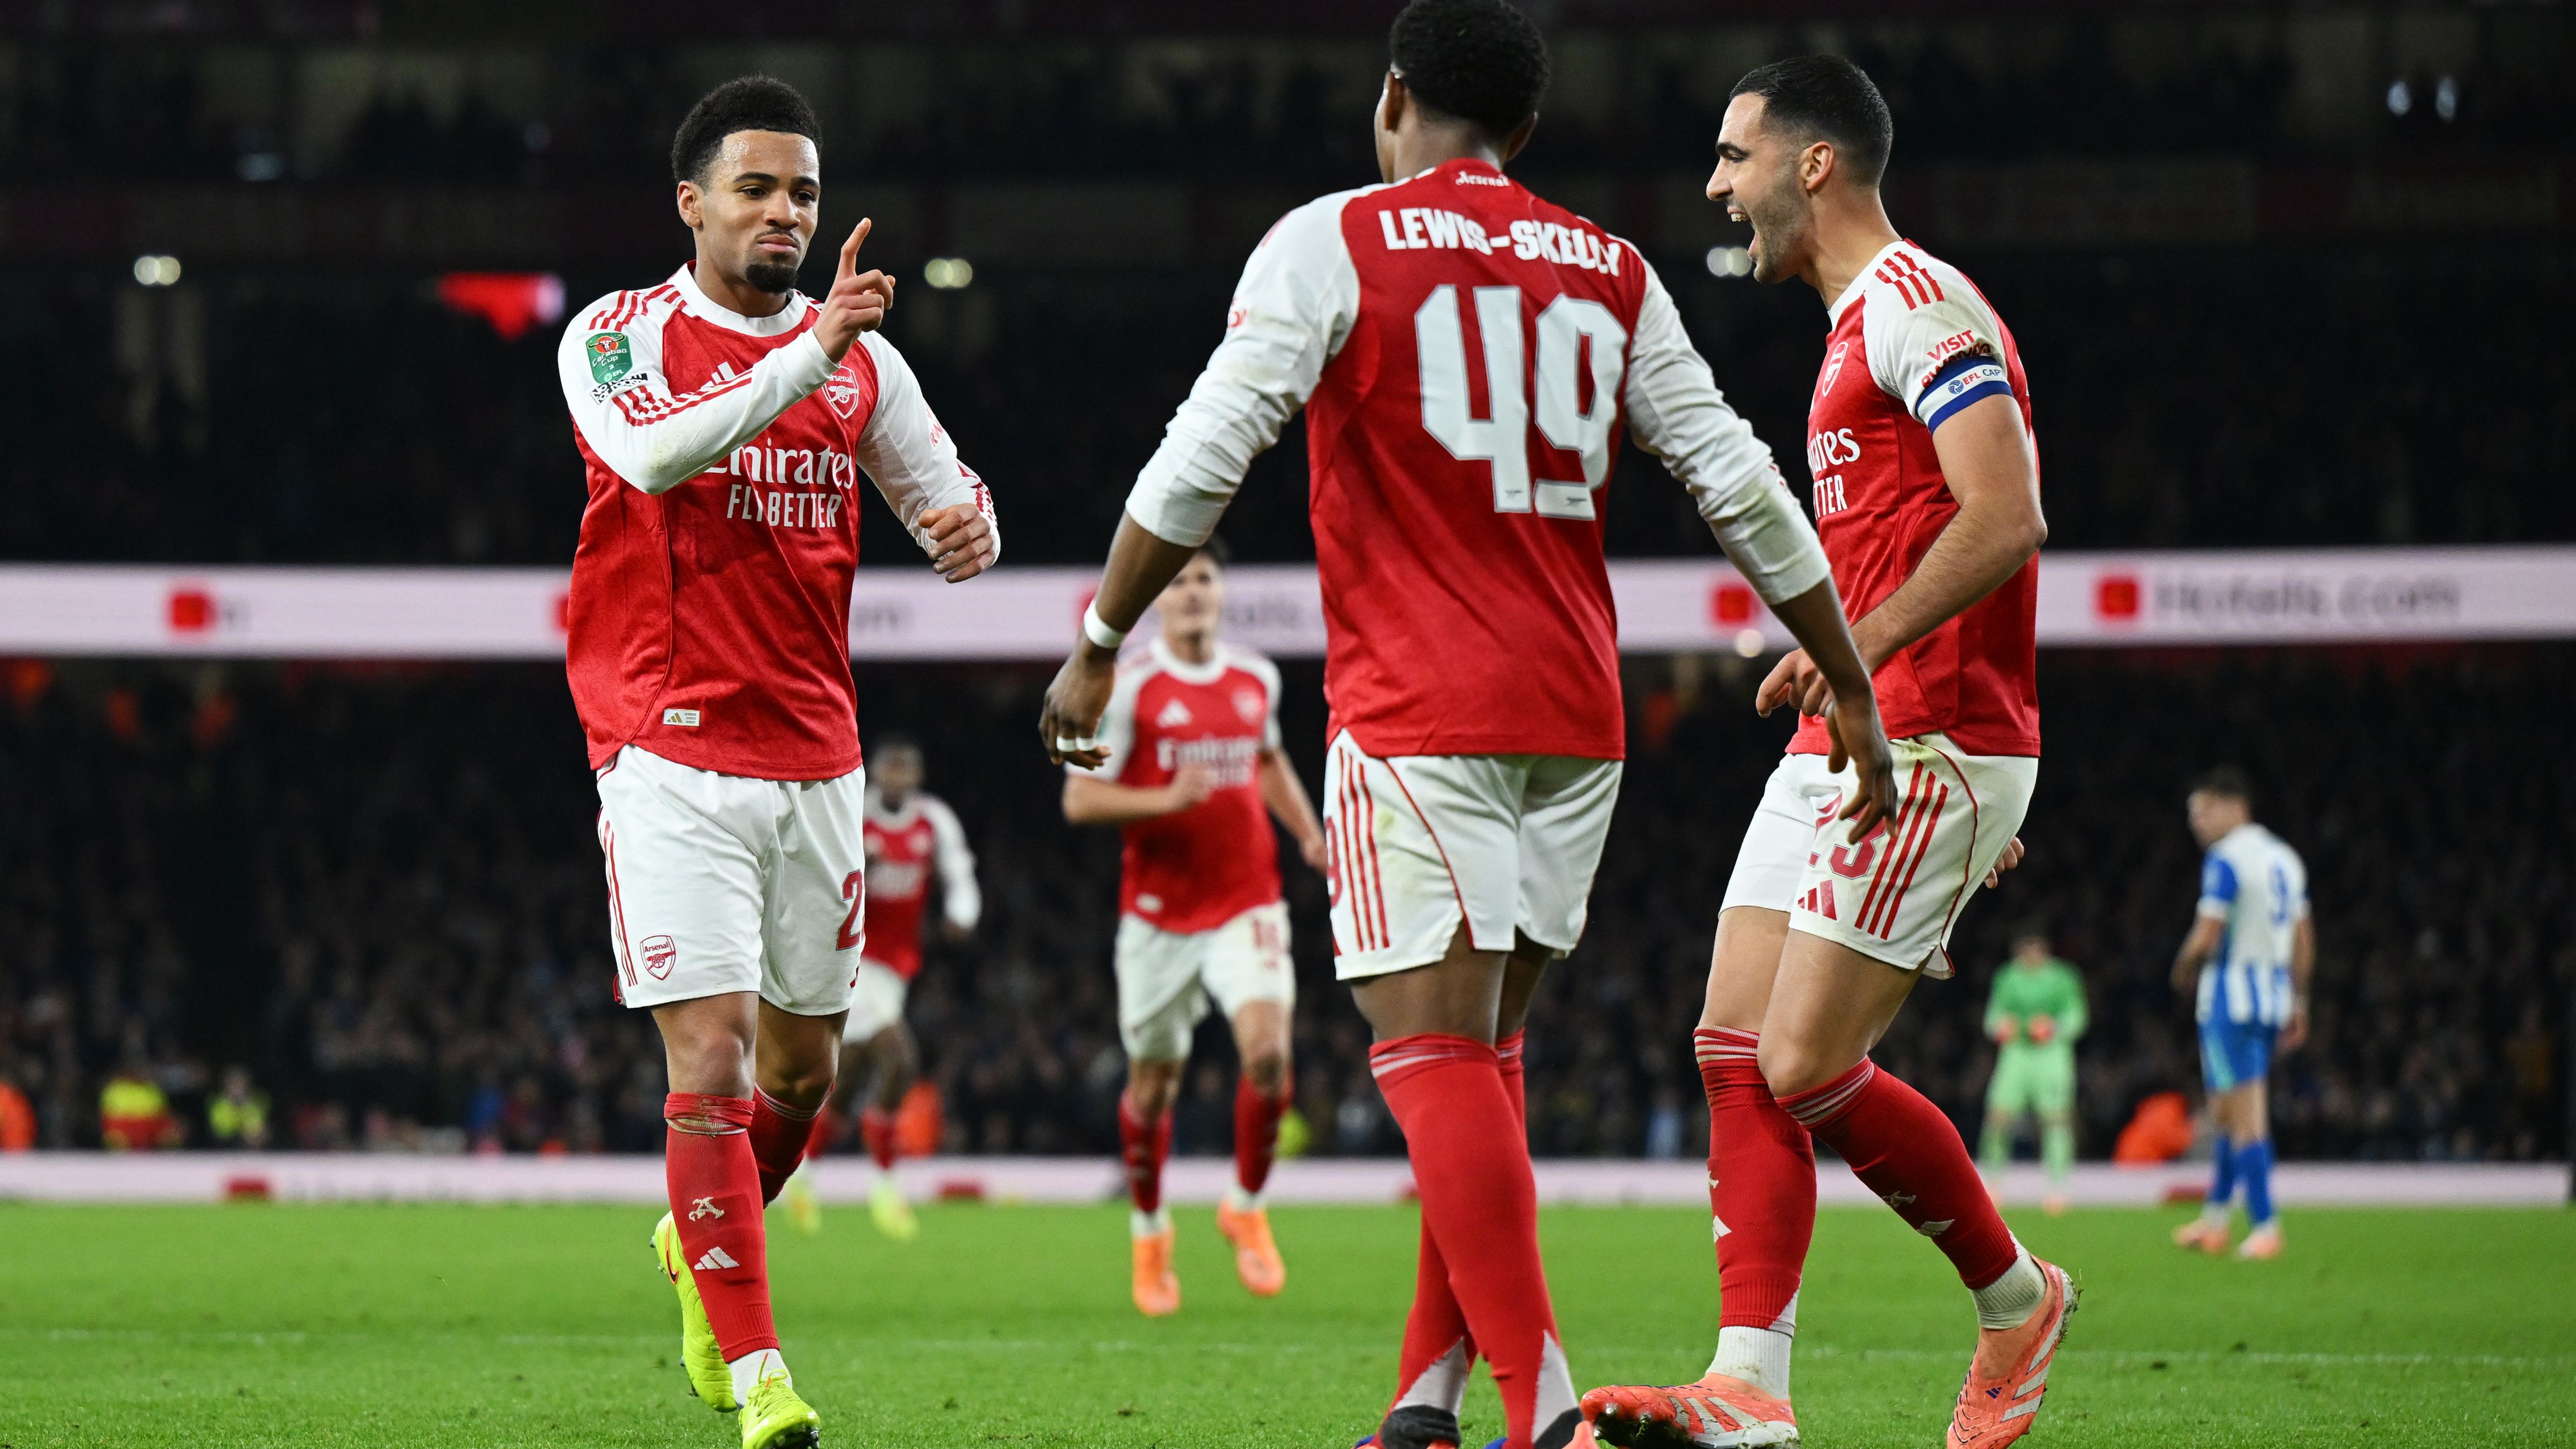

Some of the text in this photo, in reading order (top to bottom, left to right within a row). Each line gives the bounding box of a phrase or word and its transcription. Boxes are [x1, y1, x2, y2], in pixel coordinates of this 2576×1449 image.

[1455, 170, 1510, 187] Arsenal
[1378, 207, 1621, 277] LEWIS-SKELLY
[592, 348, 627, 367] Carabao
[601, 355, 618, 366] Cup
[1927, 329, 1975, 361] VISIT
[1963, 372, 1981, 385] EFL
[1415, 284, 1628, 521] 49
[704, 437, 854, 490] mirates
[767, 491, 843, 528] BETTER
[1813, 474, 1848, 521] TTER
[644, 941, 669, 952] Arsenal
